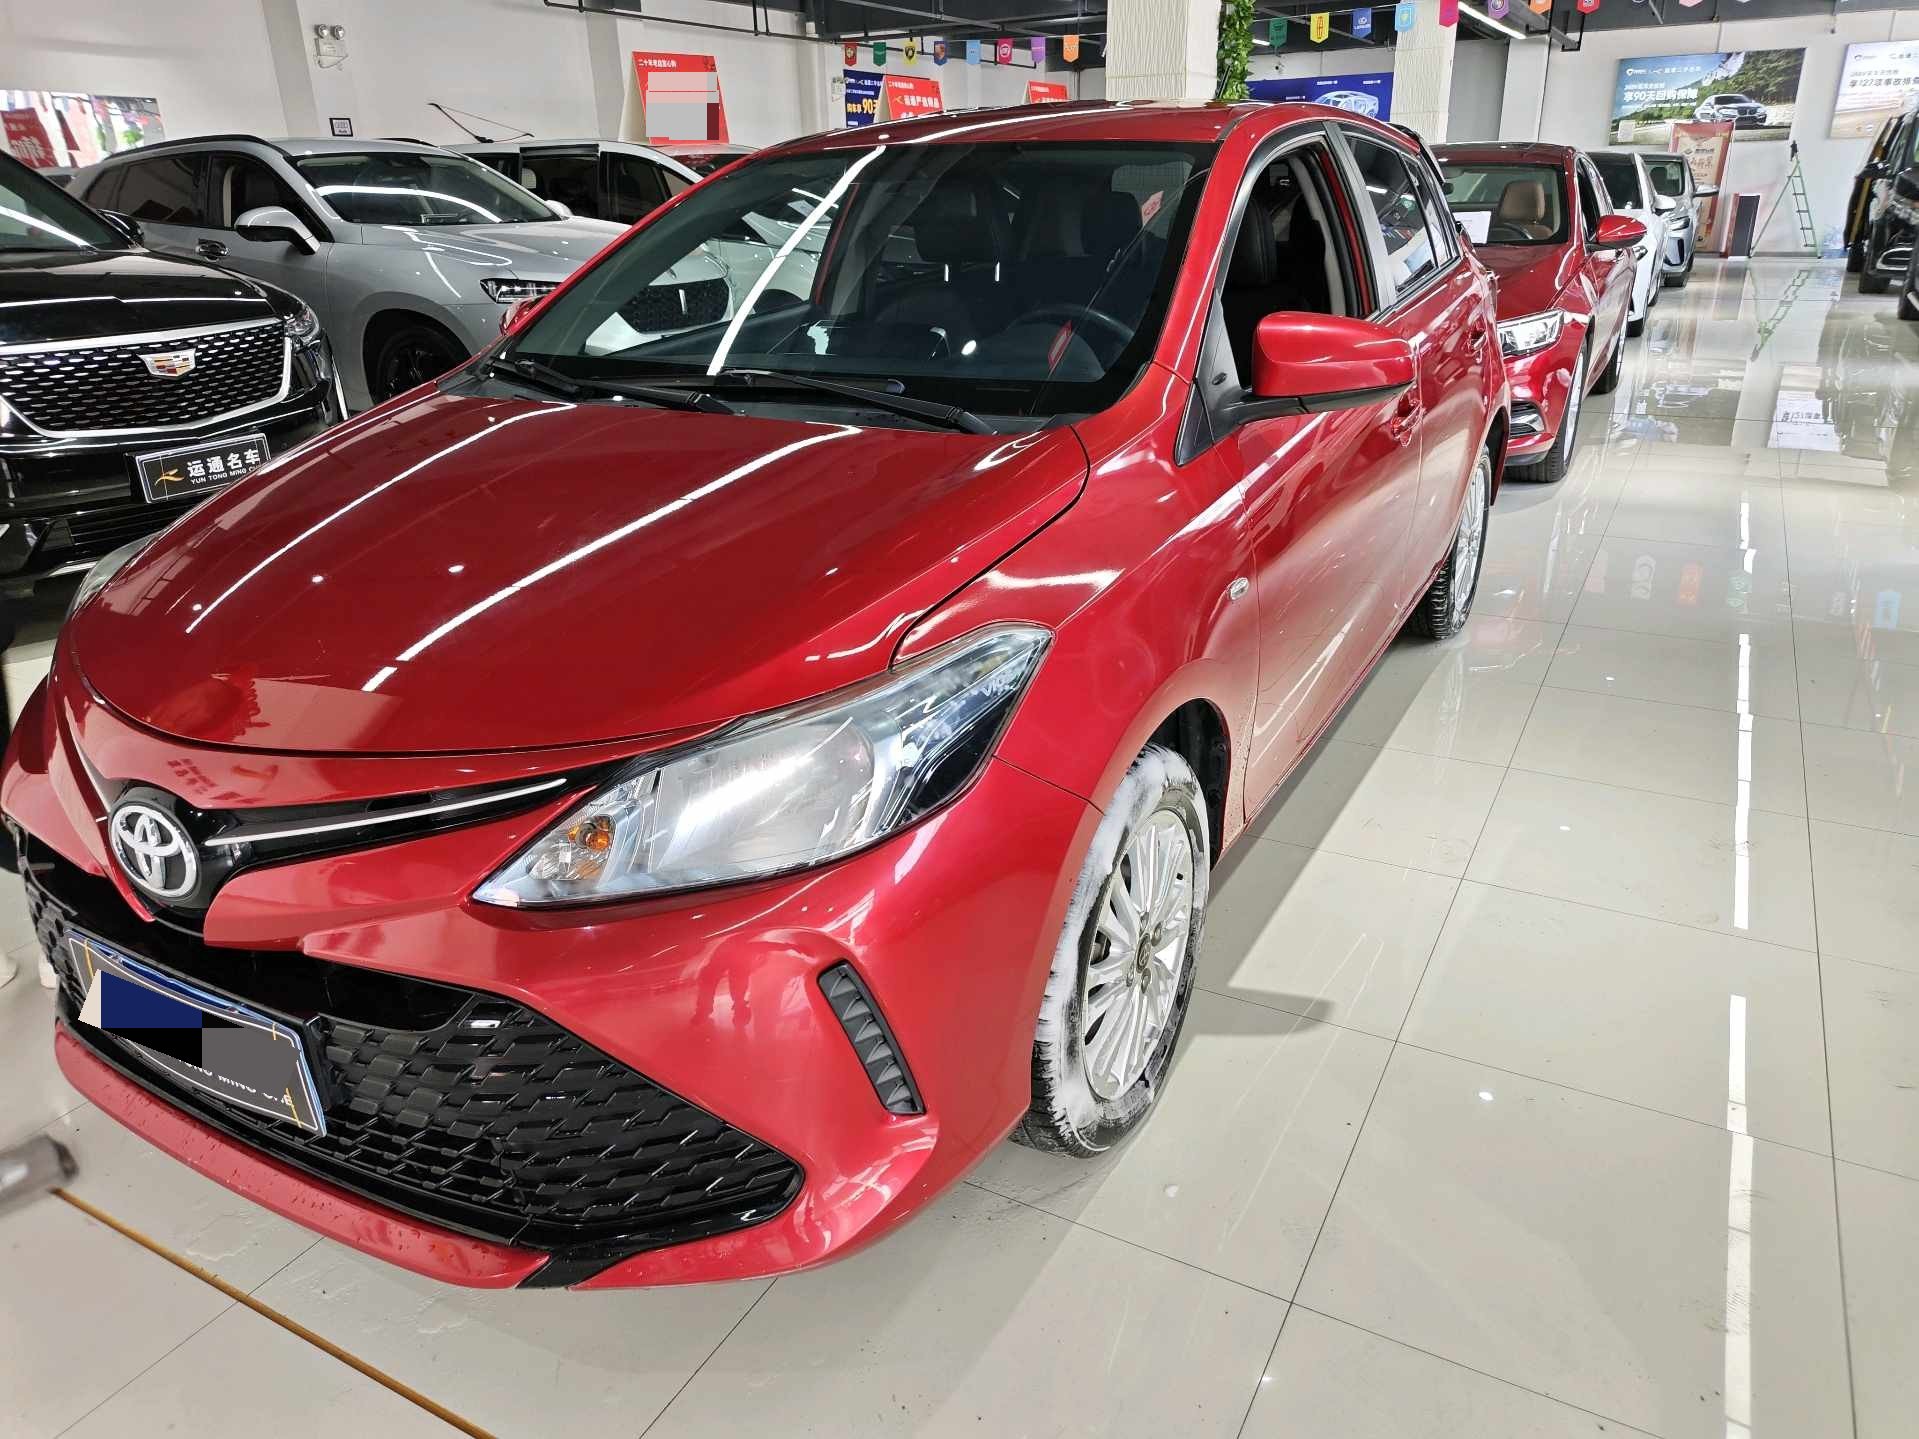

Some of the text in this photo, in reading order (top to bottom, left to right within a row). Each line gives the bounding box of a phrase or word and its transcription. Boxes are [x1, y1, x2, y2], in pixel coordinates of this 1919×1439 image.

[187, 449, 260, 477] 运通名车
[191, 477, 206, 485] YUN
[208, 472, 228, 481] TONG
[229, 468, 247, 476] MING
